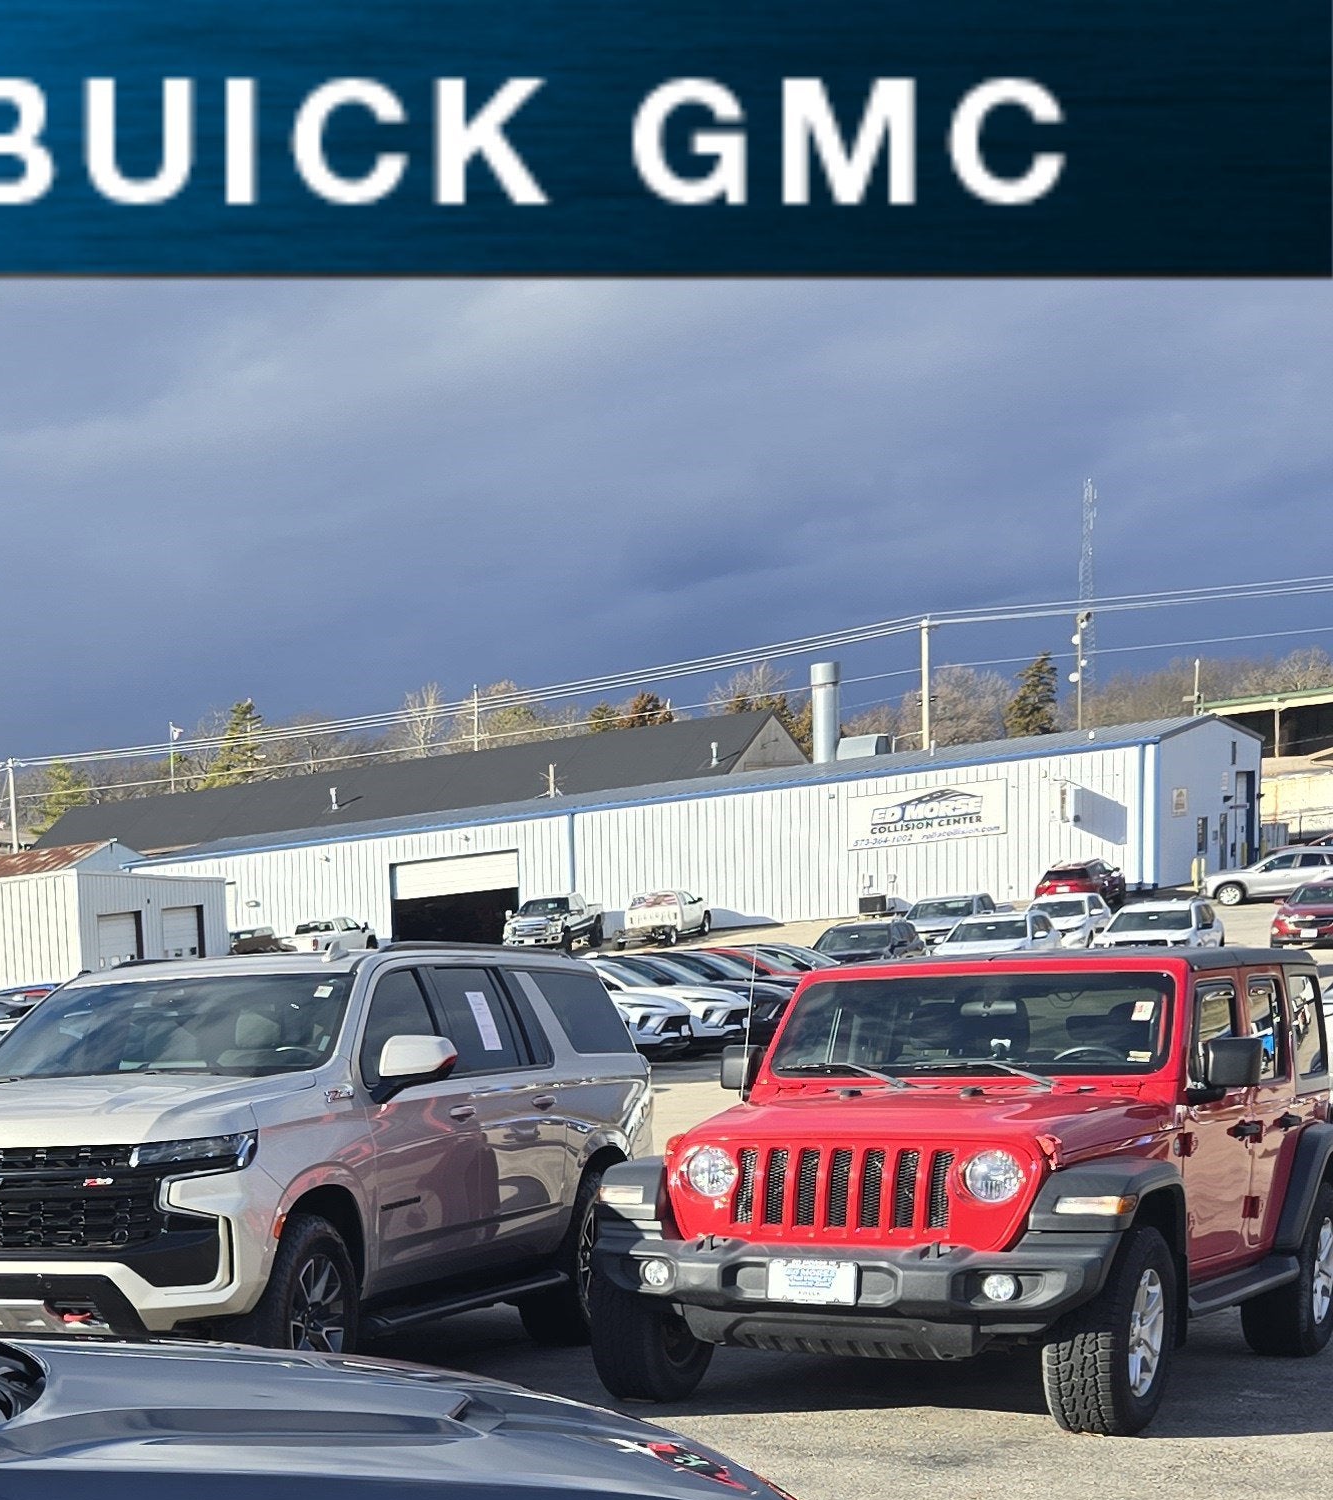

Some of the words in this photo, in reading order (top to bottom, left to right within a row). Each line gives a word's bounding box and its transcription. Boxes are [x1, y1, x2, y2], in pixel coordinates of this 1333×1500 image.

[871, 805, 903, 826] ED
[903, 798, 983, 823] MORSE
[870, 821, 934, 835] COLLISION
[938, 815, 983, 827] CENTER
[853, 833, 914, 848] 573-364-1002
